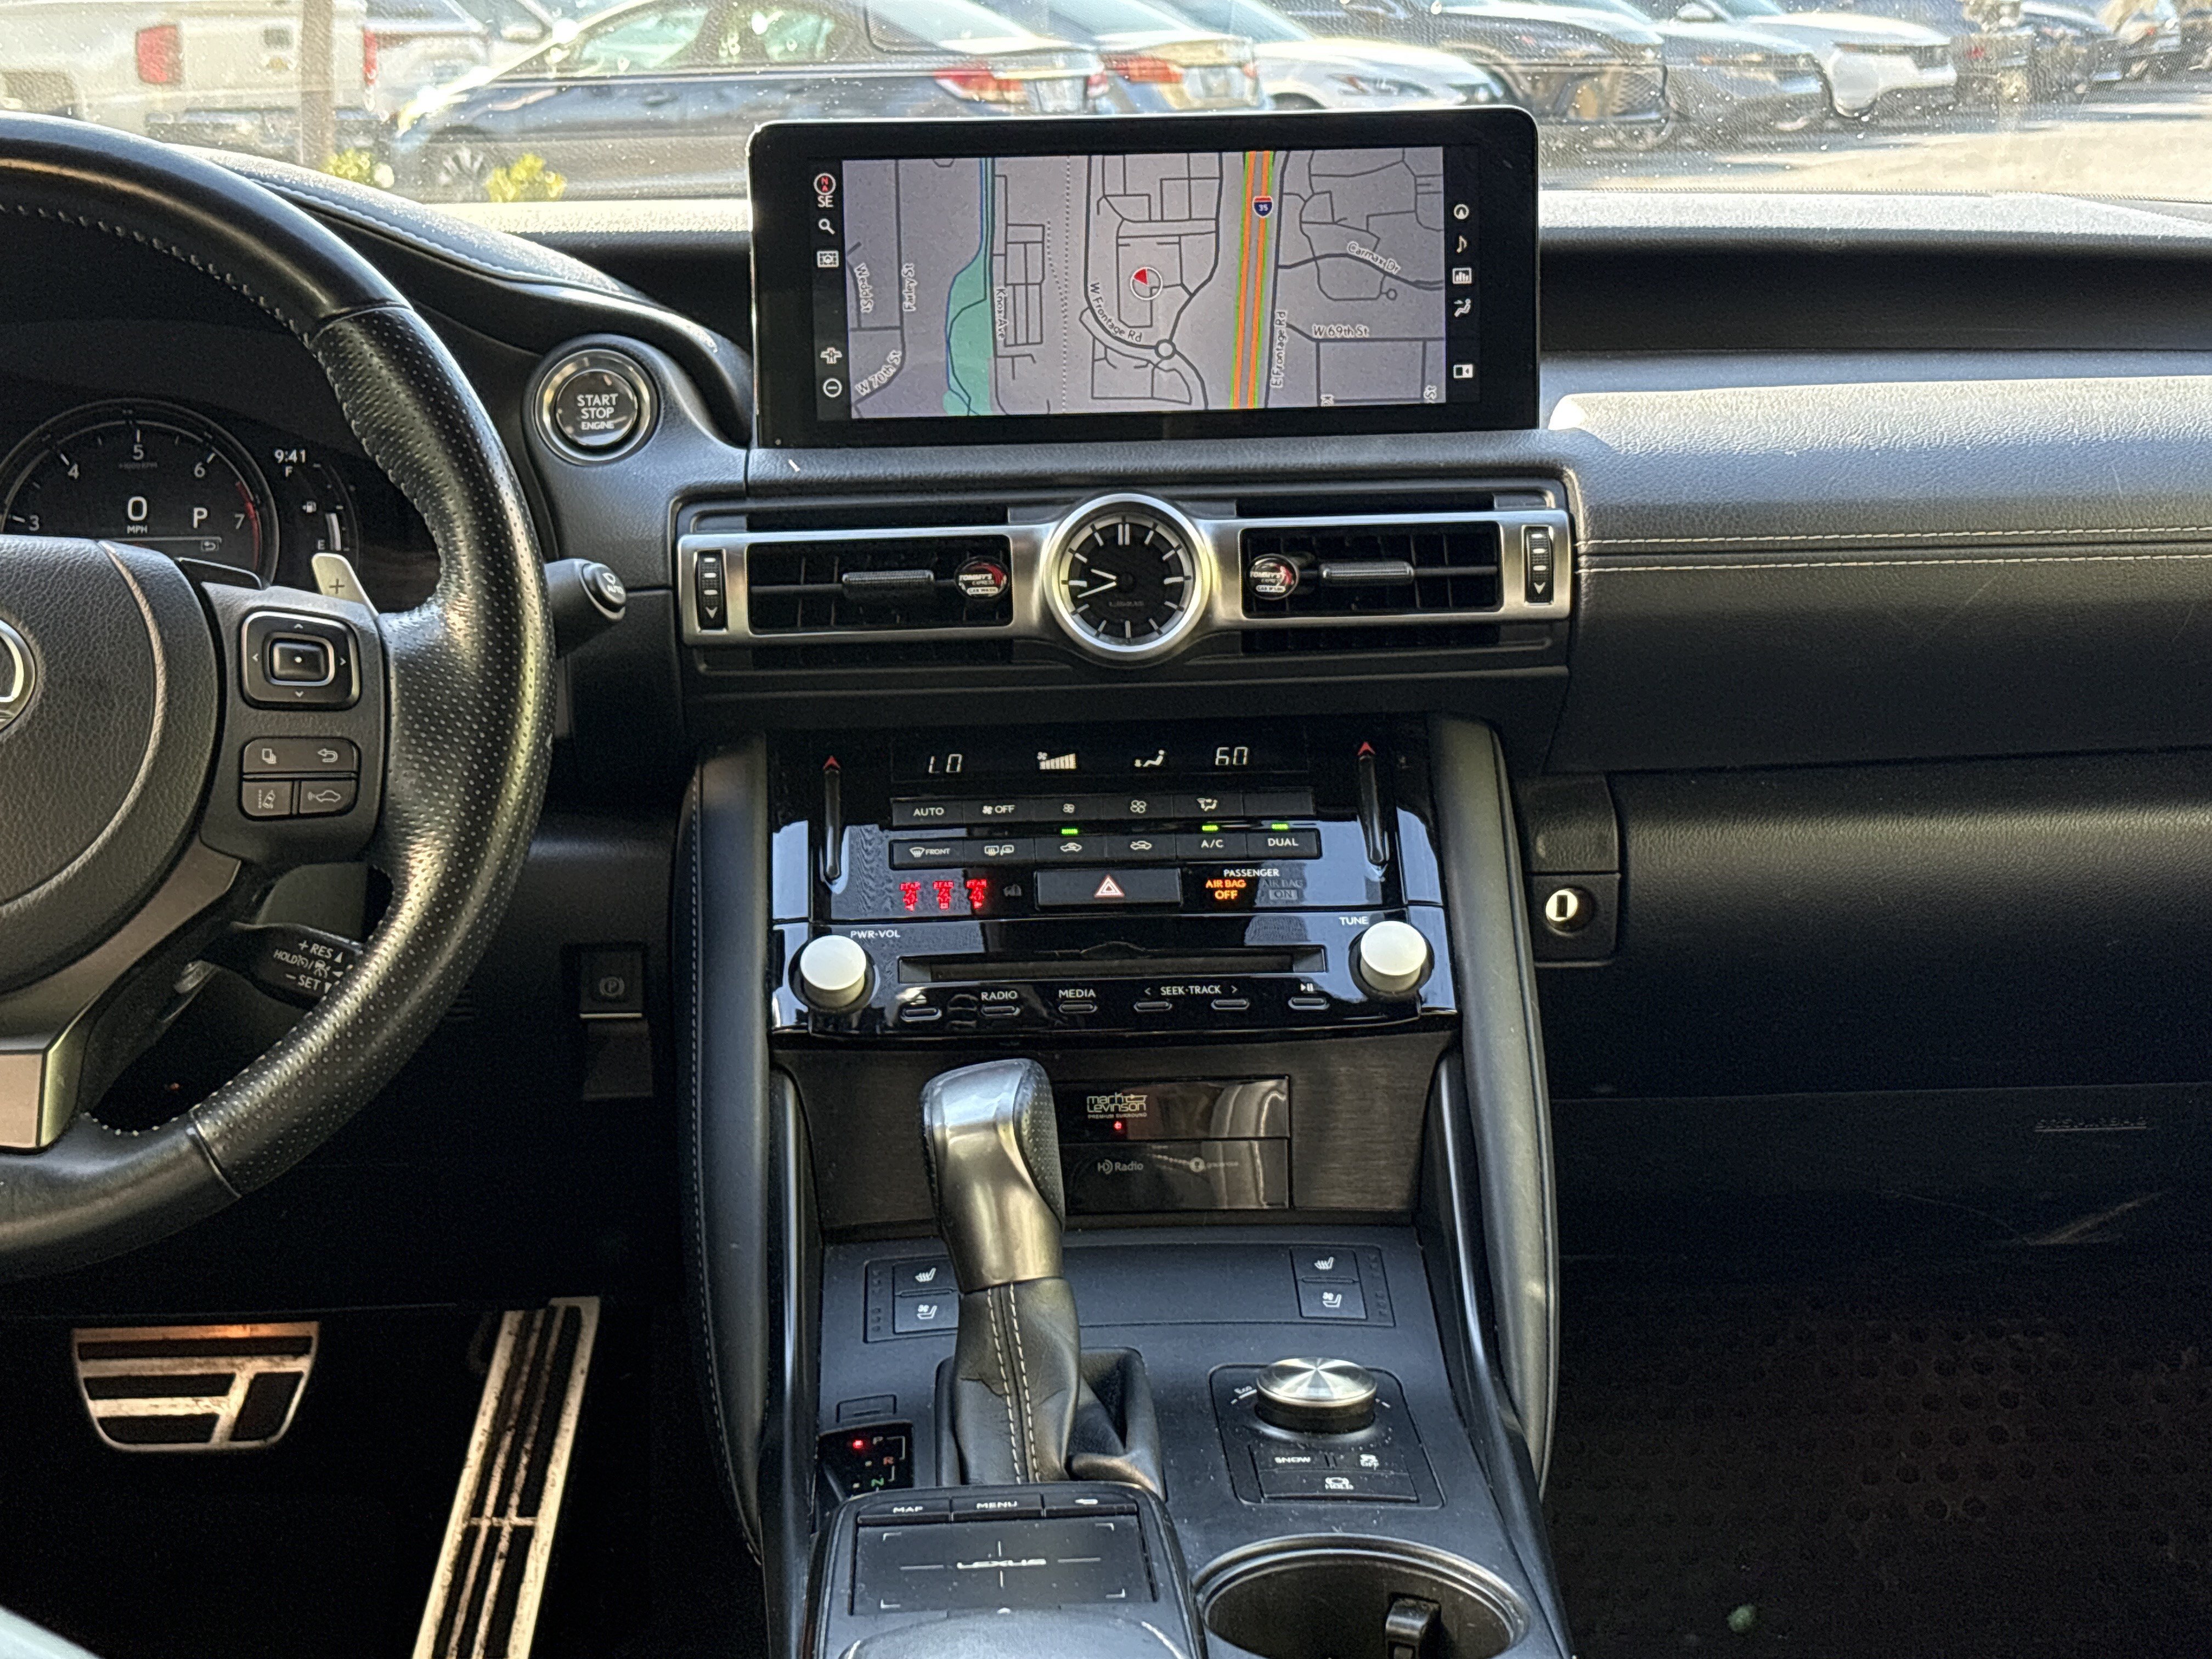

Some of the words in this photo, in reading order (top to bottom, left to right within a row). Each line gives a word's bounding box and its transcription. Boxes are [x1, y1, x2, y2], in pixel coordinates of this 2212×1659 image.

[817, 195, 834, 208] SE
[1258, 204, 1268, 212] 35
[1348, 243, 1386, 266] Carmax
[1386, 258, 1400, 273] Dr
[903, 264, 913, 276] St
[1090, 282, 1100, 294] W
[904, 279, 917, 311] Farley
[996, 288, 1006, 314] Knox
[862, 299, 872, 312] St
[1092, 296, 1125, 336] Frontage
[1276, 311, 1286, 327] Rd
[997, 318, 1008, 339] Ave
[1313, 325, 1327, 337] W
[1328, 324, 1355, 337] 69th
[1357, 325, 1369, 336] St
[1127, 330, 1143, 342] Rd
[1273, 328, 1286, 380] Frontage
[856, 380, 870, 395] W
[868, 365, 895, 387] 70th
[888, 351, 901, 365] St
[1272, 375, 1282, 386] E
[577, 393, 618, 407] START
[581, 407, 614, 419] STOP
[581, 420, 614, 430] ENGINE
[133, 444, 144, 460] 5
[274, 449, 306, 463] 9:41
[67, 463, 80, 479] 4
[194, 462, 206, 478] 6
[285, 466, 294, 477] F
[127, 496, 147, 521] 0
[29, 515, 40, 532] 3
[194, 507, 208, 528] P
[234, 513, 245, 529] 7
[127, 525, 148, 534] MPH
[317, 539, 325, 550] E
[1215, 747, 1249, 766] 60
[913, 807, 945, 816] AUTO
[995, 805, 1015, 814] OFF
[1201, 839, 1224, 848] A/C
[1267, 838, 1299, 847] DUAL
[1223, 868, 1280, 877] PASSENGER
[1206, 879, 1223, 888] AIR
[1224, 879, 1246, 888] BAG
[1262, 880, 1280, 888] AIR
[1282, 879, 1303, 888] BAG
[1214, 889, 1238, 900] OFF
[1274, 890, 1293, 899] ON
[1339, 916, 1369, 926] TUNE
[273, 949, 298, 964] HOLD
[309, 943, 334, 959] RES
[298, 974, 321, 991] SET
[981, 991, 1018, 1001] RADIO
[1058, 989, 1096, 998] MEDIA
[1114, 1160, 1144, 1171] Radio
[977, 1501, 1018, 1509] MENU
